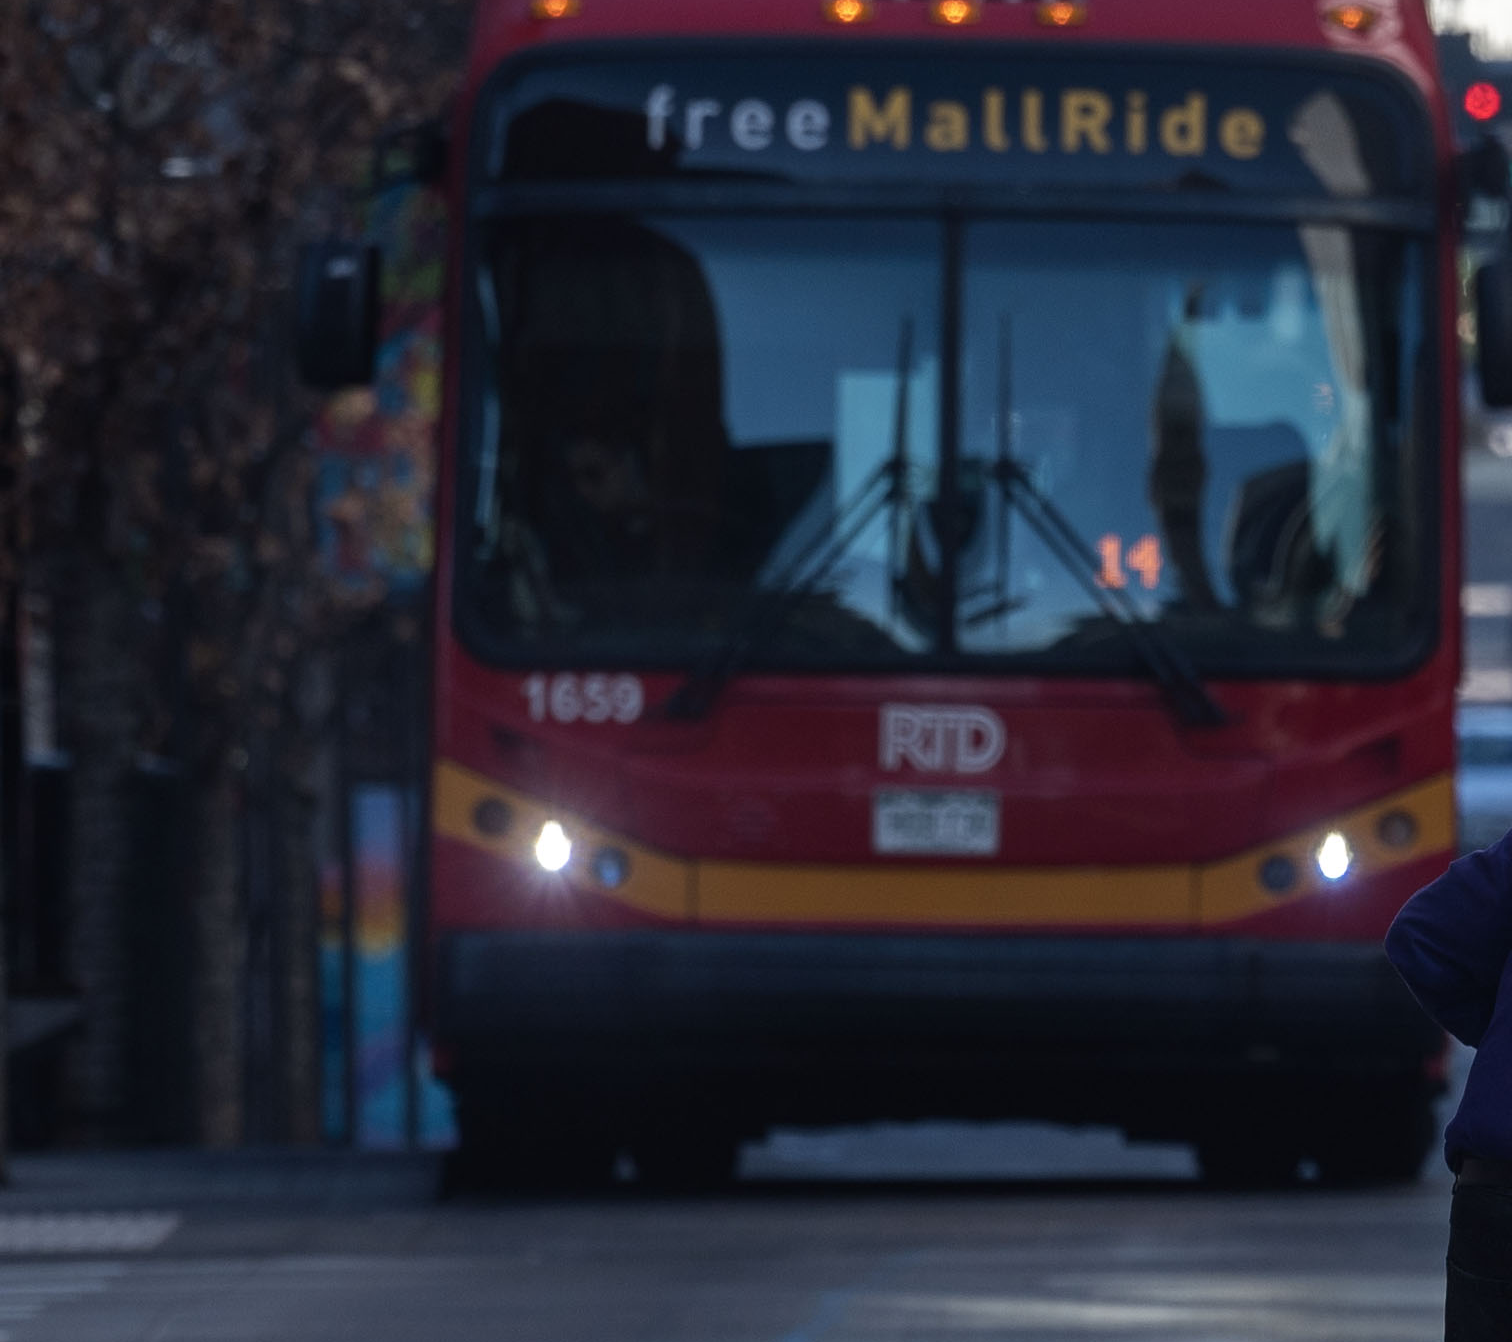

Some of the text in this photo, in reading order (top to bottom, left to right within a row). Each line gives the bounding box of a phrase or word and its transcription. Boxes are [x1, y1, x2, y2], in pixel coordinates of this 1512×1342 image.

[1094, 533, 1163, 590] 14
[522, 672, 644, 723] 1659
[879, 703, 1006, 773] RTD
